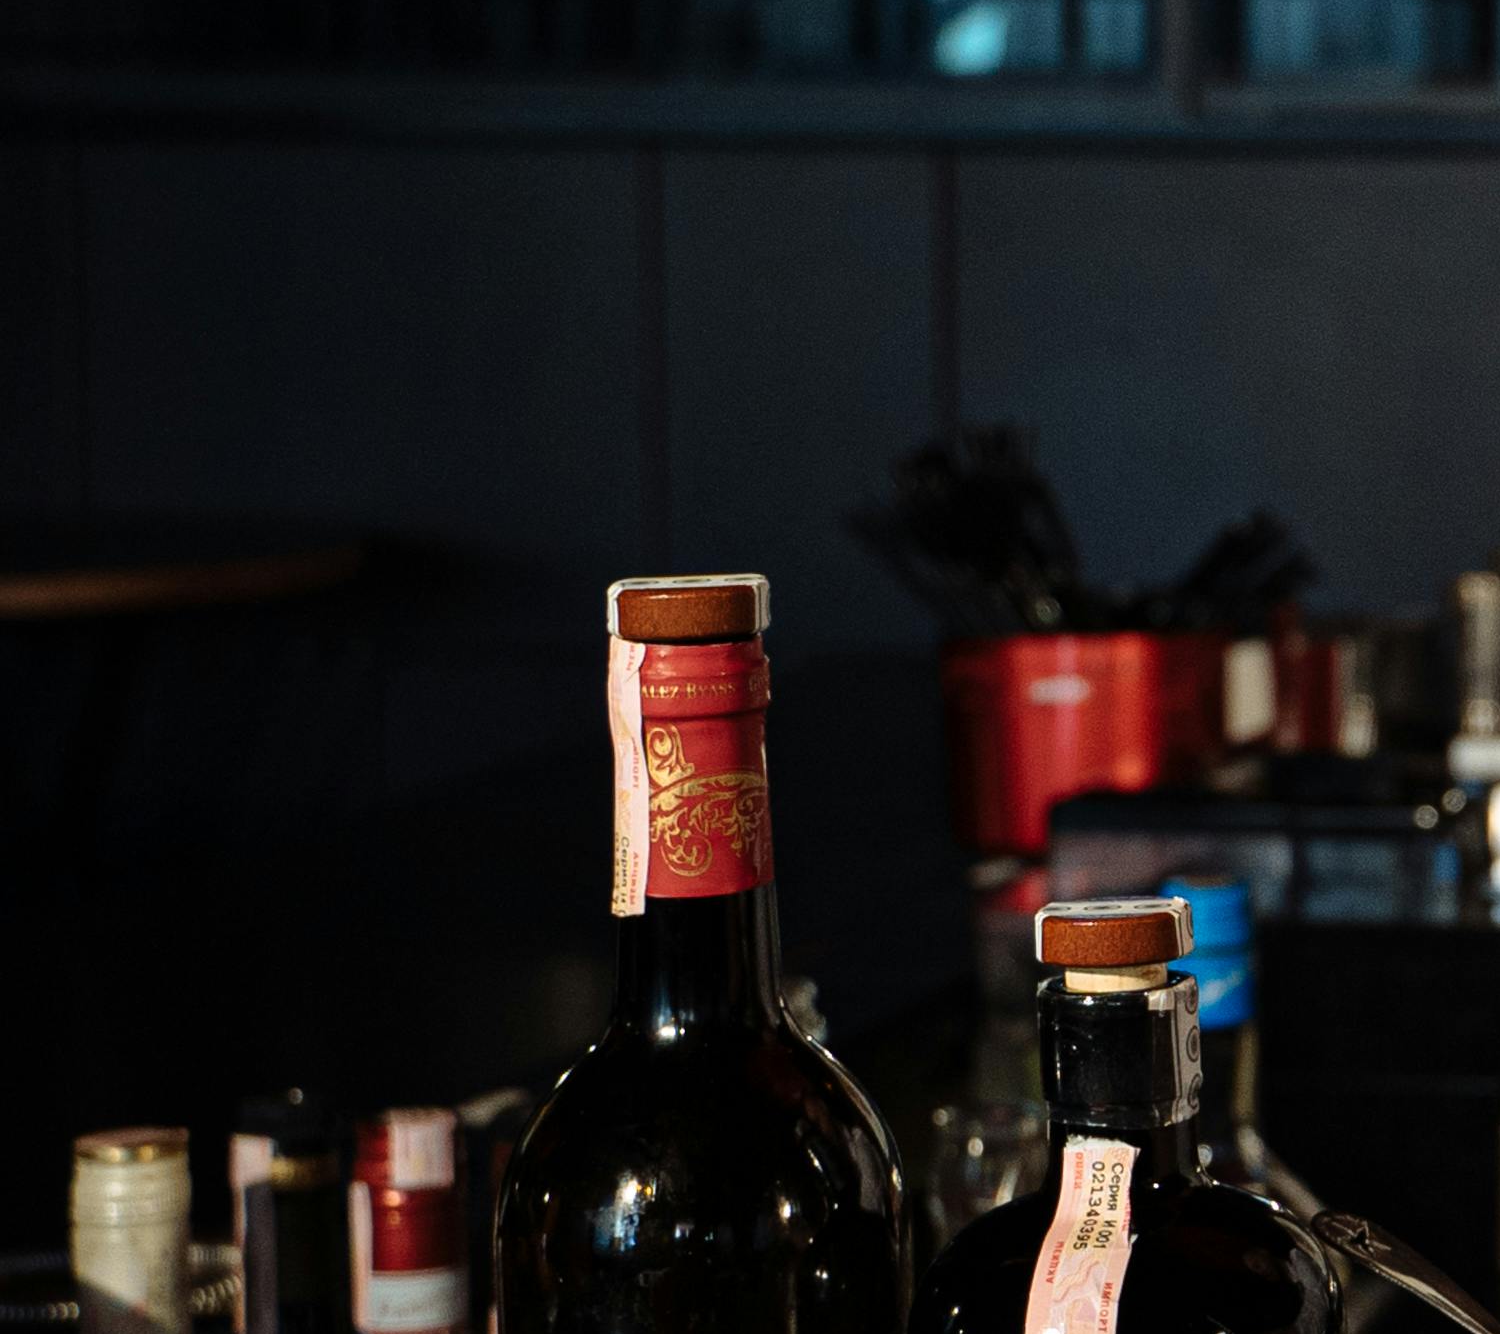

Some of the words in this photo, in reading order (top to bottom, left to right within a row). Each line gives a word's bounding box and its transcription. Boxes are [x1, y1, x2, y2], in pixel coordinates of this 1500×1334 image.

[641, 682, 679, 700] ALEZ
[1073, 1161, 1105, 1250] 021340395
[1107, 1162, 1124, 1211] Серия
[1098, 1282, 1114, 1333] ИМПОРТ
